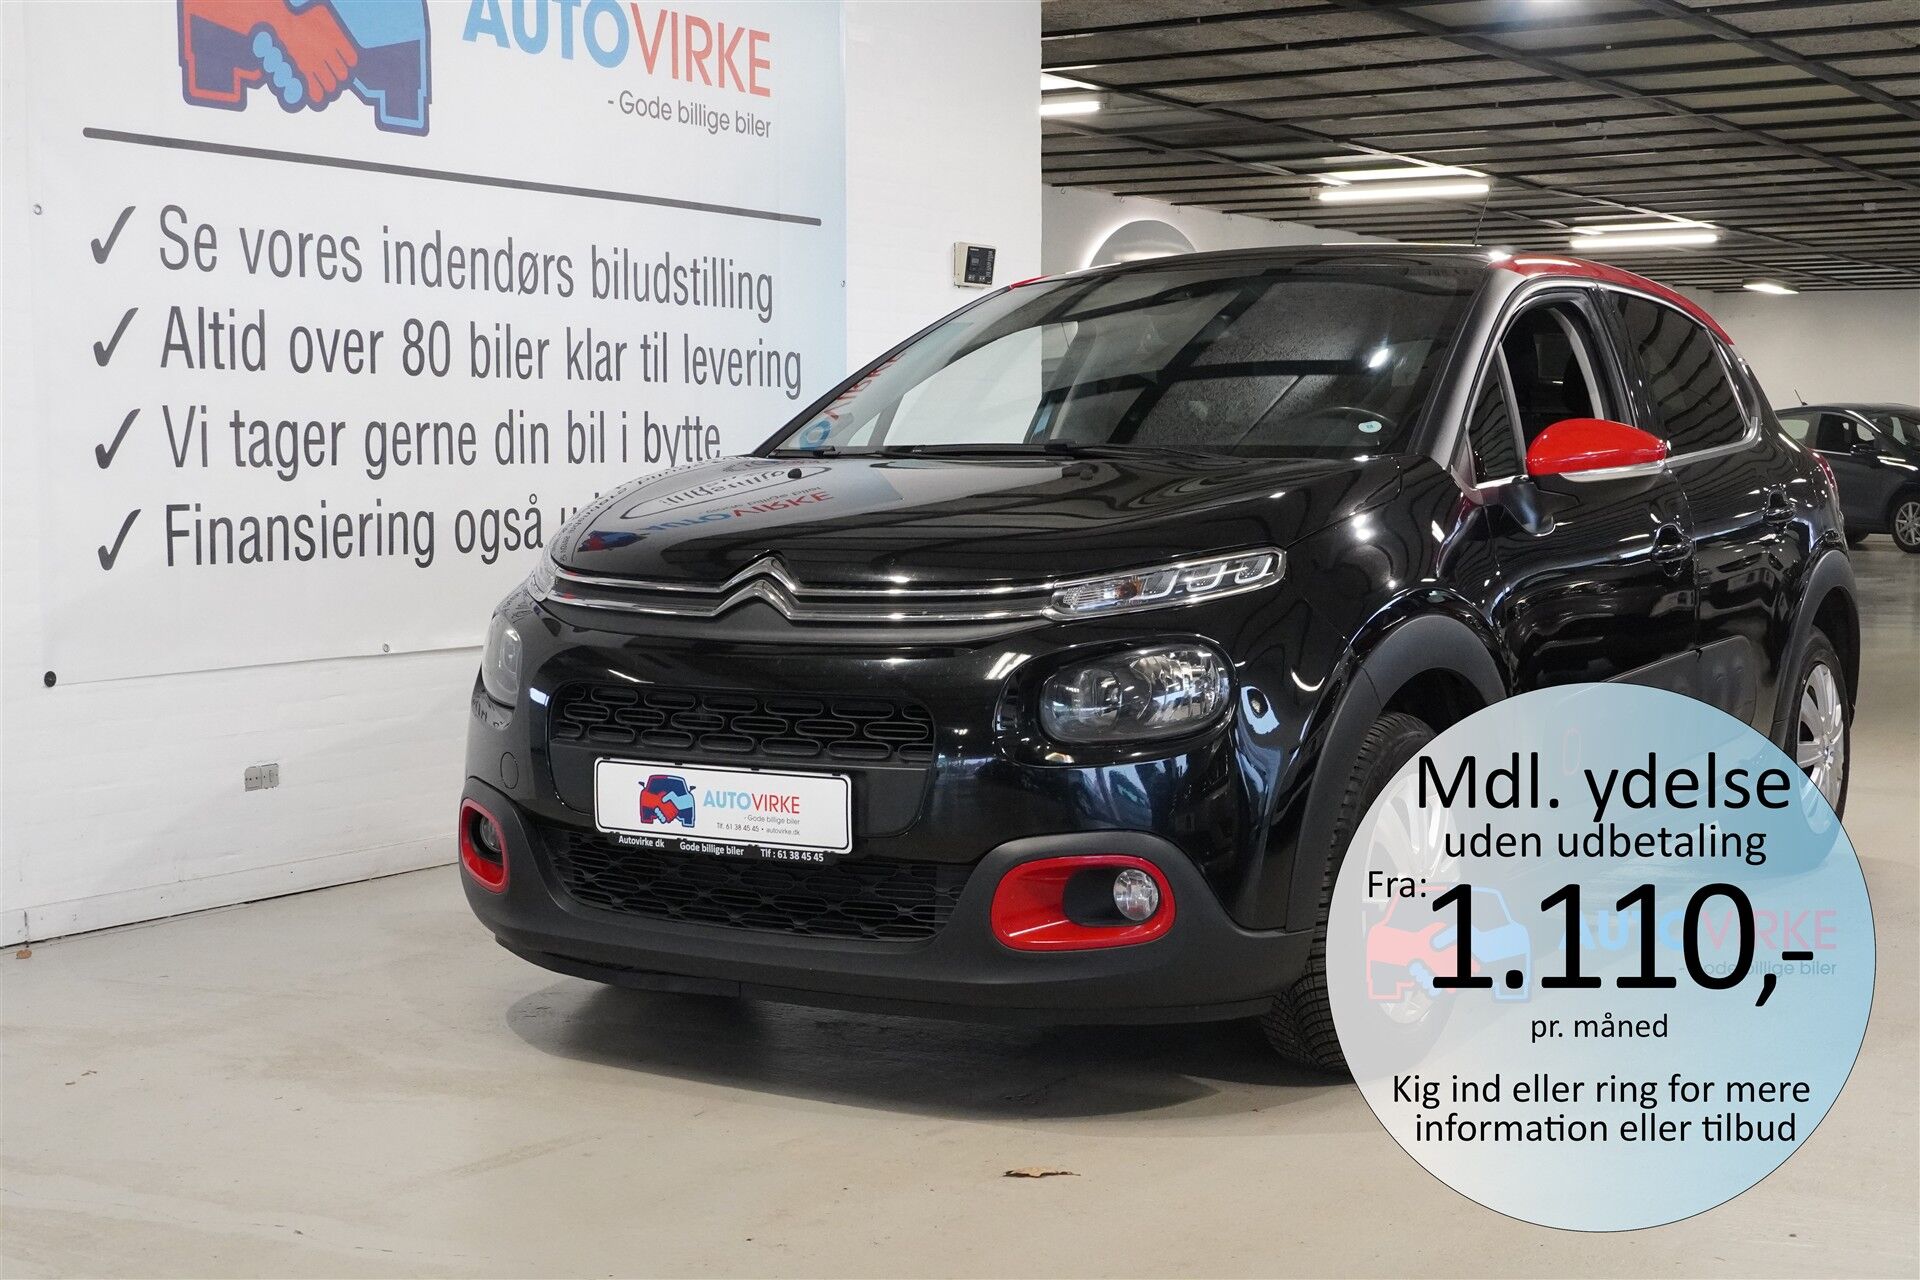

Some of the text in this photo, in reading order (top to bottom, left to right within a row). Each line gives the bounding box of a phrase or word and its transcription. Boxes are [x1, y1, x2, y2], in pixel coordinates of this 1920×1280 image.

[462, 0, 771, 97] AUTOVIRKE
[619, 89, 673, 121] Gode
[677, 99, 730, 135] billige
[735, 110, 771, 139] biler
[159, 204, 774, 324] Se vores indendørs biludstilling
[160, 305, 266, 372] Altid
[289, 326, 384, 375] over
[402, 318, 451, 379] 80
[470, 320, 550, 381] biler
[566, 326, 628, 383] klar
[639, 331, 668, 384] til
[683, 333, 802, 401] levering
[161, 404, 721, 482] Vi tager gerne din bil i bytte
[165, 498, 435, 569] Finansiering
[454, 493, 545, 566] også
[702, 789, 800, 815] AUTOVIRKE
[748, 814, 766, 823] Gode
[766, 815, 785, 826] billige
[786, 816, 800, 825] biler
[618, 835, 653, 847] Autovirke
[655, 838, 665, 849] dk
[679, 841, 700, 852] Gode
[701, 842, 725, 856] billige
[726, 844, 744, 856] biler
[777, 850, 788, 859] 61
[789, 851, 800, 860] 38
[801, 851, 811, 861] 45
[813, 852, 824, 862] 45
